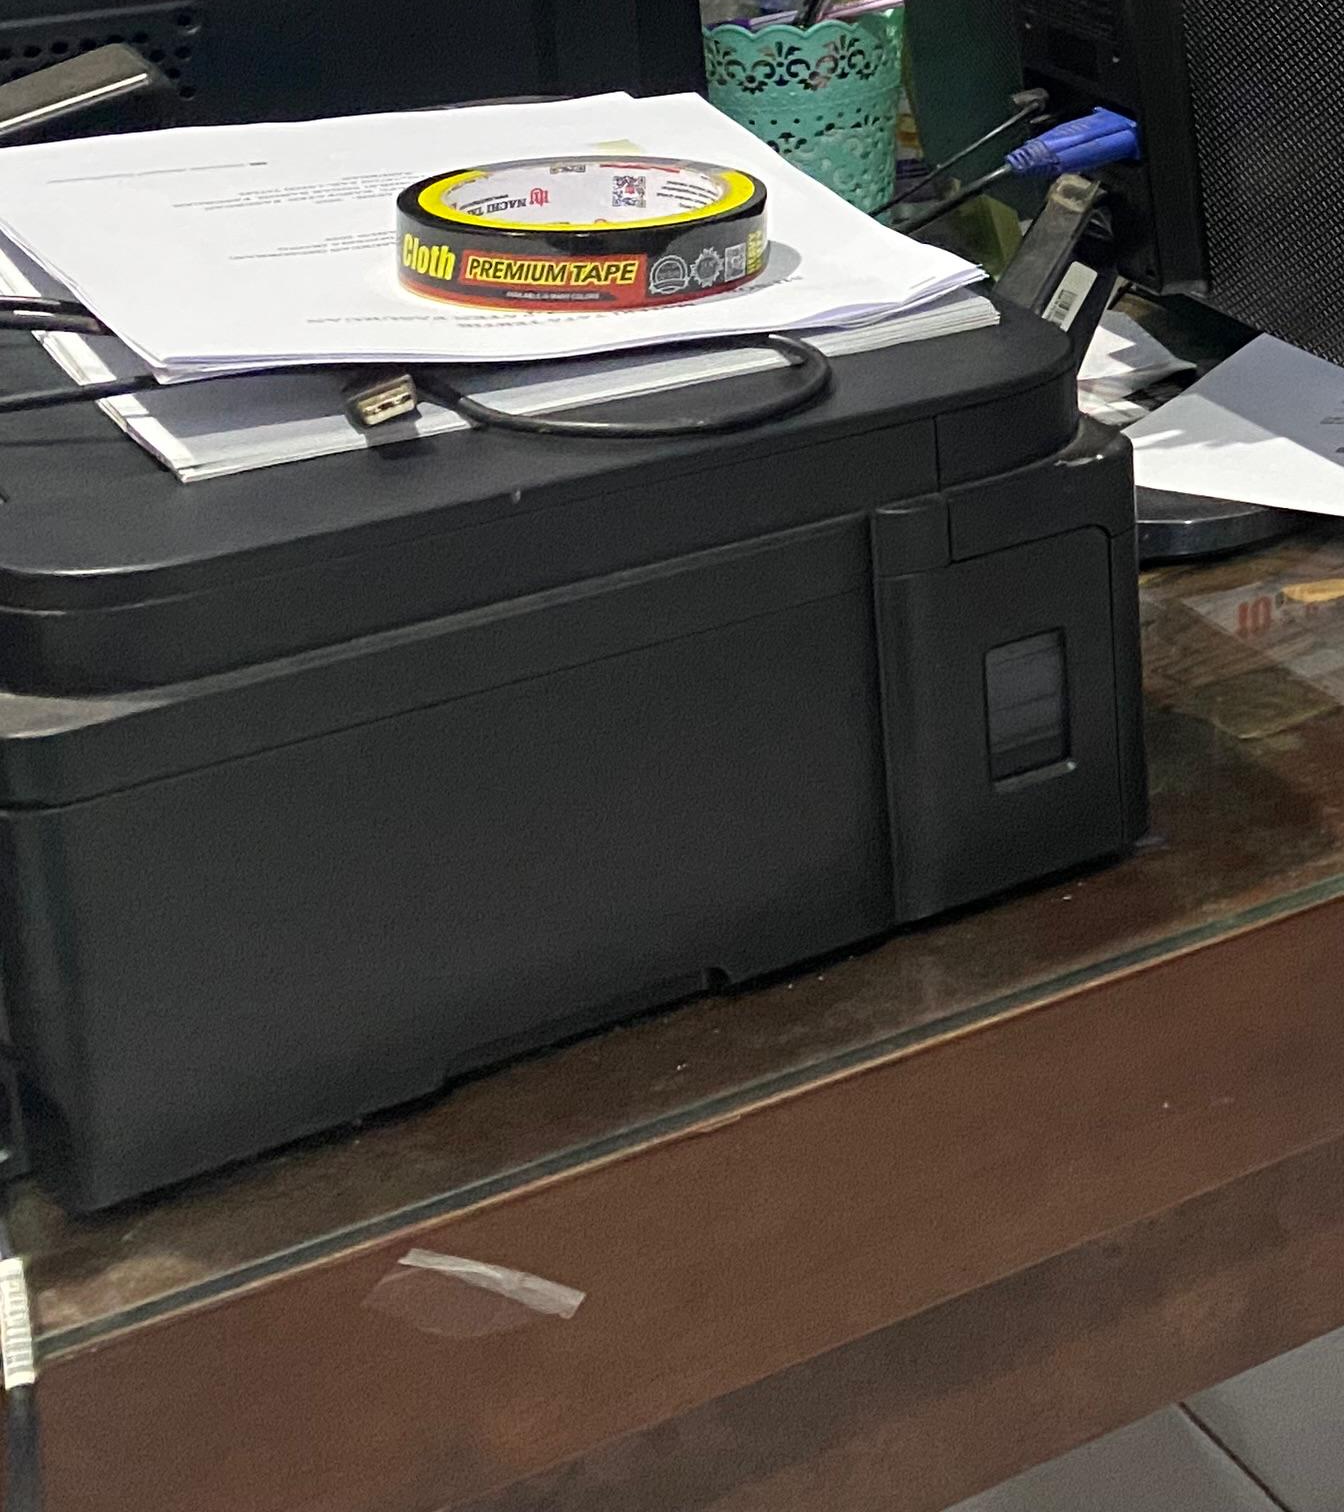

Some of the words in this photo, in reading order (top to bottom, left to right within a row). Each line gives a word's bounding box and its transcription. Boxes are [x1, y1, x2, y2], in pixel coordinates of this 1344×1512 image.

[487, 197, 527, 215] NACHI
[402, 233, 457, 281] Cloth
[466, 256, 568, 283] PREMIUM
[569, 261, 639, 285] TAPE
